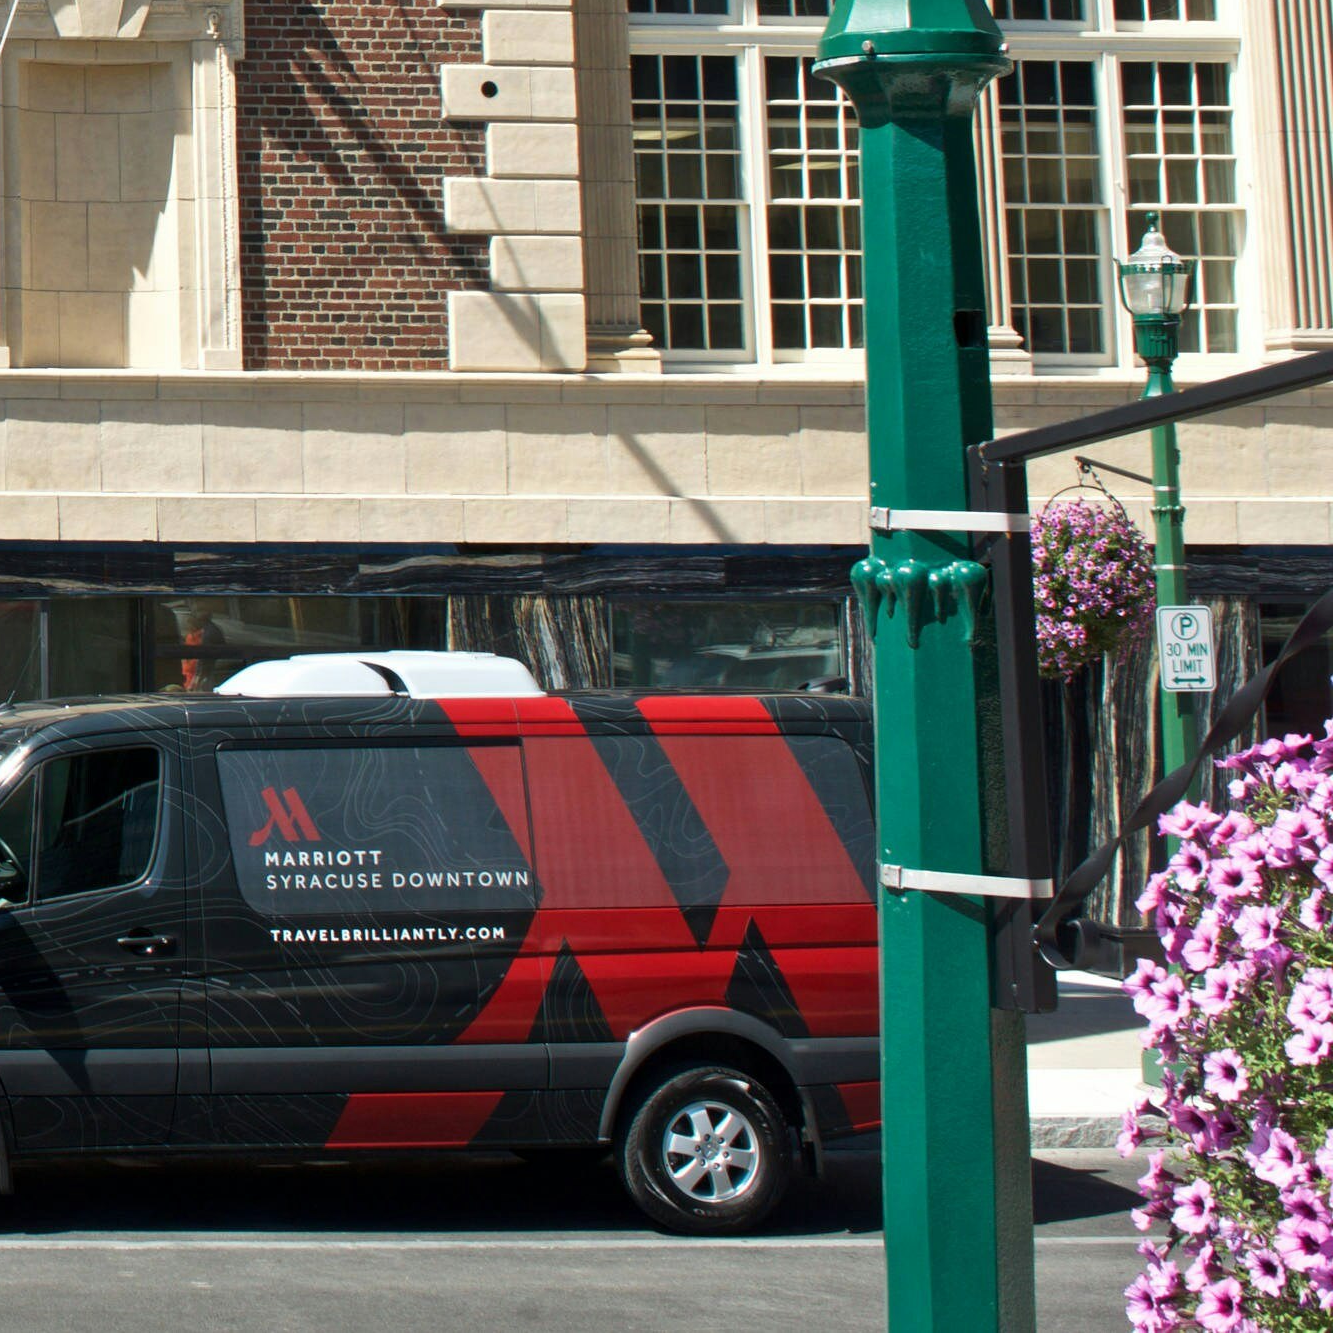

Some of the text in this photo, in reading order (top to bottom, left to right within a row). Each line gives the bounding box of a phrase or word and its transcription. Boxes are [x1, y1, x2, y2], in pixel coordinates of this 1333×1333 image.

[1179, 616, 1193, 636] P
[1166, 643, 1209, 657] 30 MIN
[1173, 659, 1204, 673] LIMIT
[265, 850, 382, 866] MARRIOTT
[266, 871, 529, 890] SYRACUSE DOWNTOWN
[270, 927, 505, 943] TRAVELBRILLIANTLY.COM
